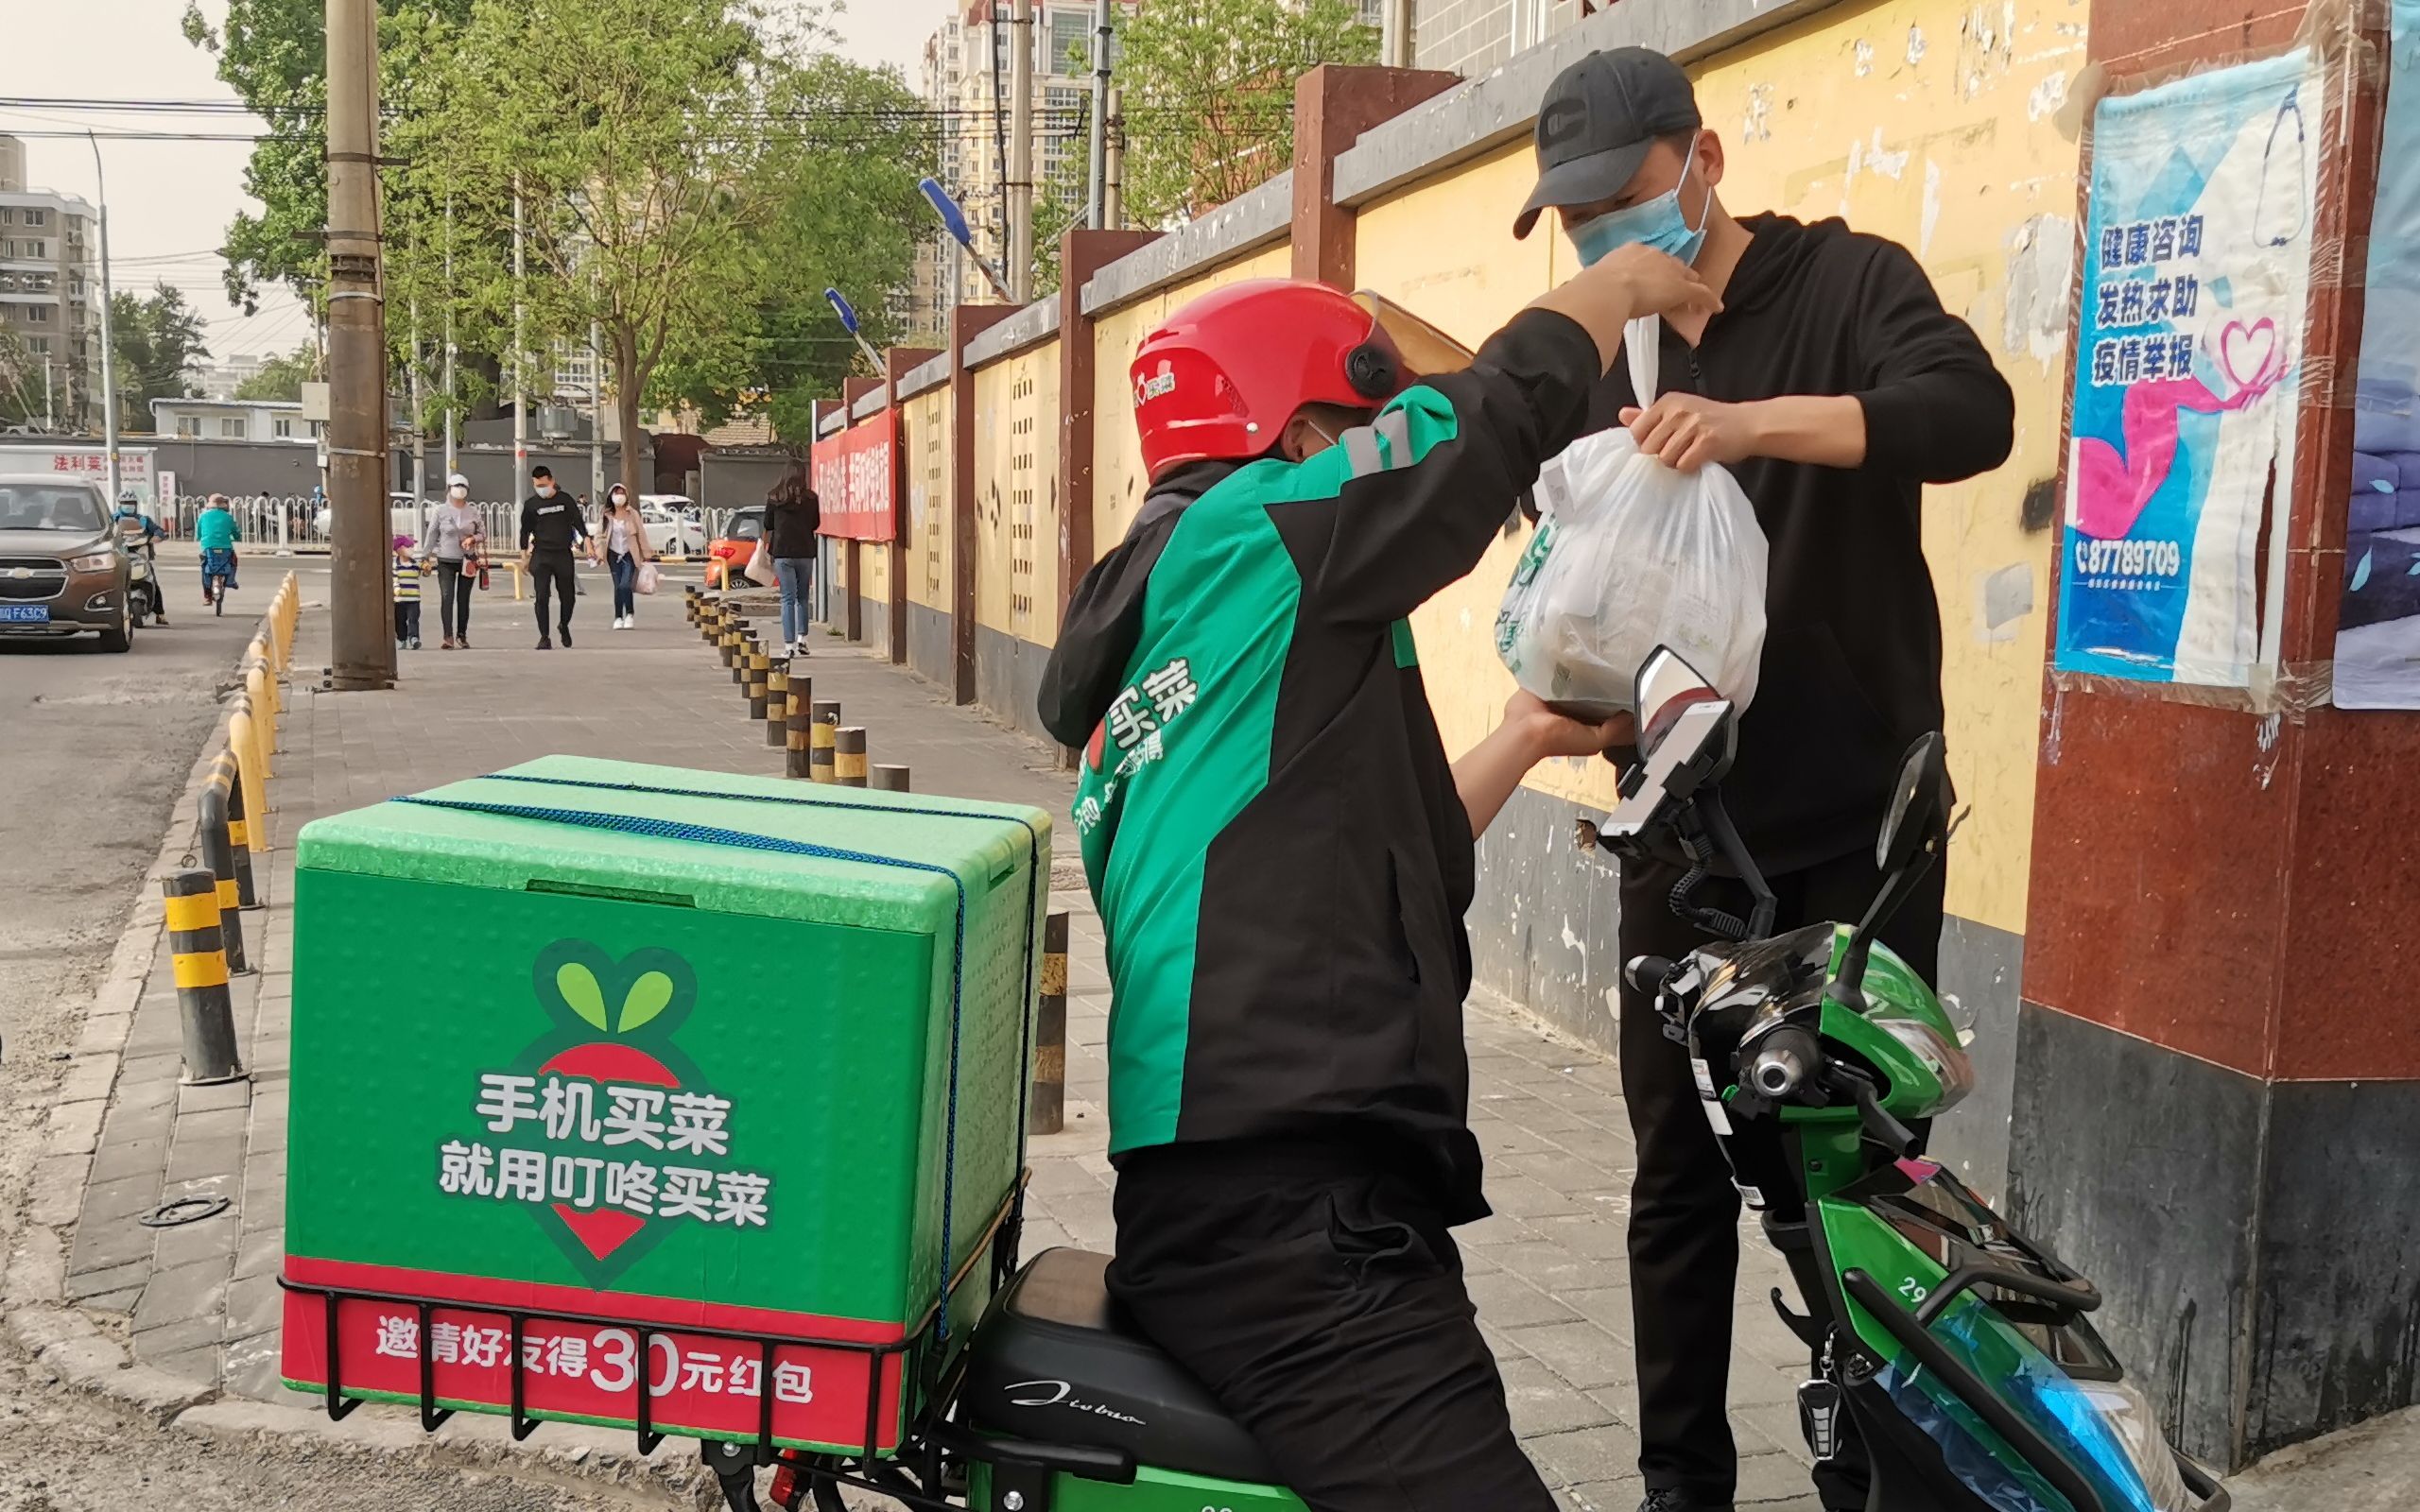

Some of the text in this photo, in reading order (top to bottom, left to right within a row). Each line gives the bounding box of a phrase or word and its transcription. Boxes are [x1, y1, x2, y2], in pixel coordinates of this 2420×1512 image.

[2100, 214, 2204, 270] 健康咨询
[2096, 273, 2199, 326] 发热求助
[2092, 334, 2194, 382] 疫情举报
[2088, 540, 2180, 576] 87789709
[475, 1074, 732, 1156] 手机买菜
[439, 1140, 770, 1227] 就用叮咚买菜
[1897, 1276, 1927, 1303] 29
